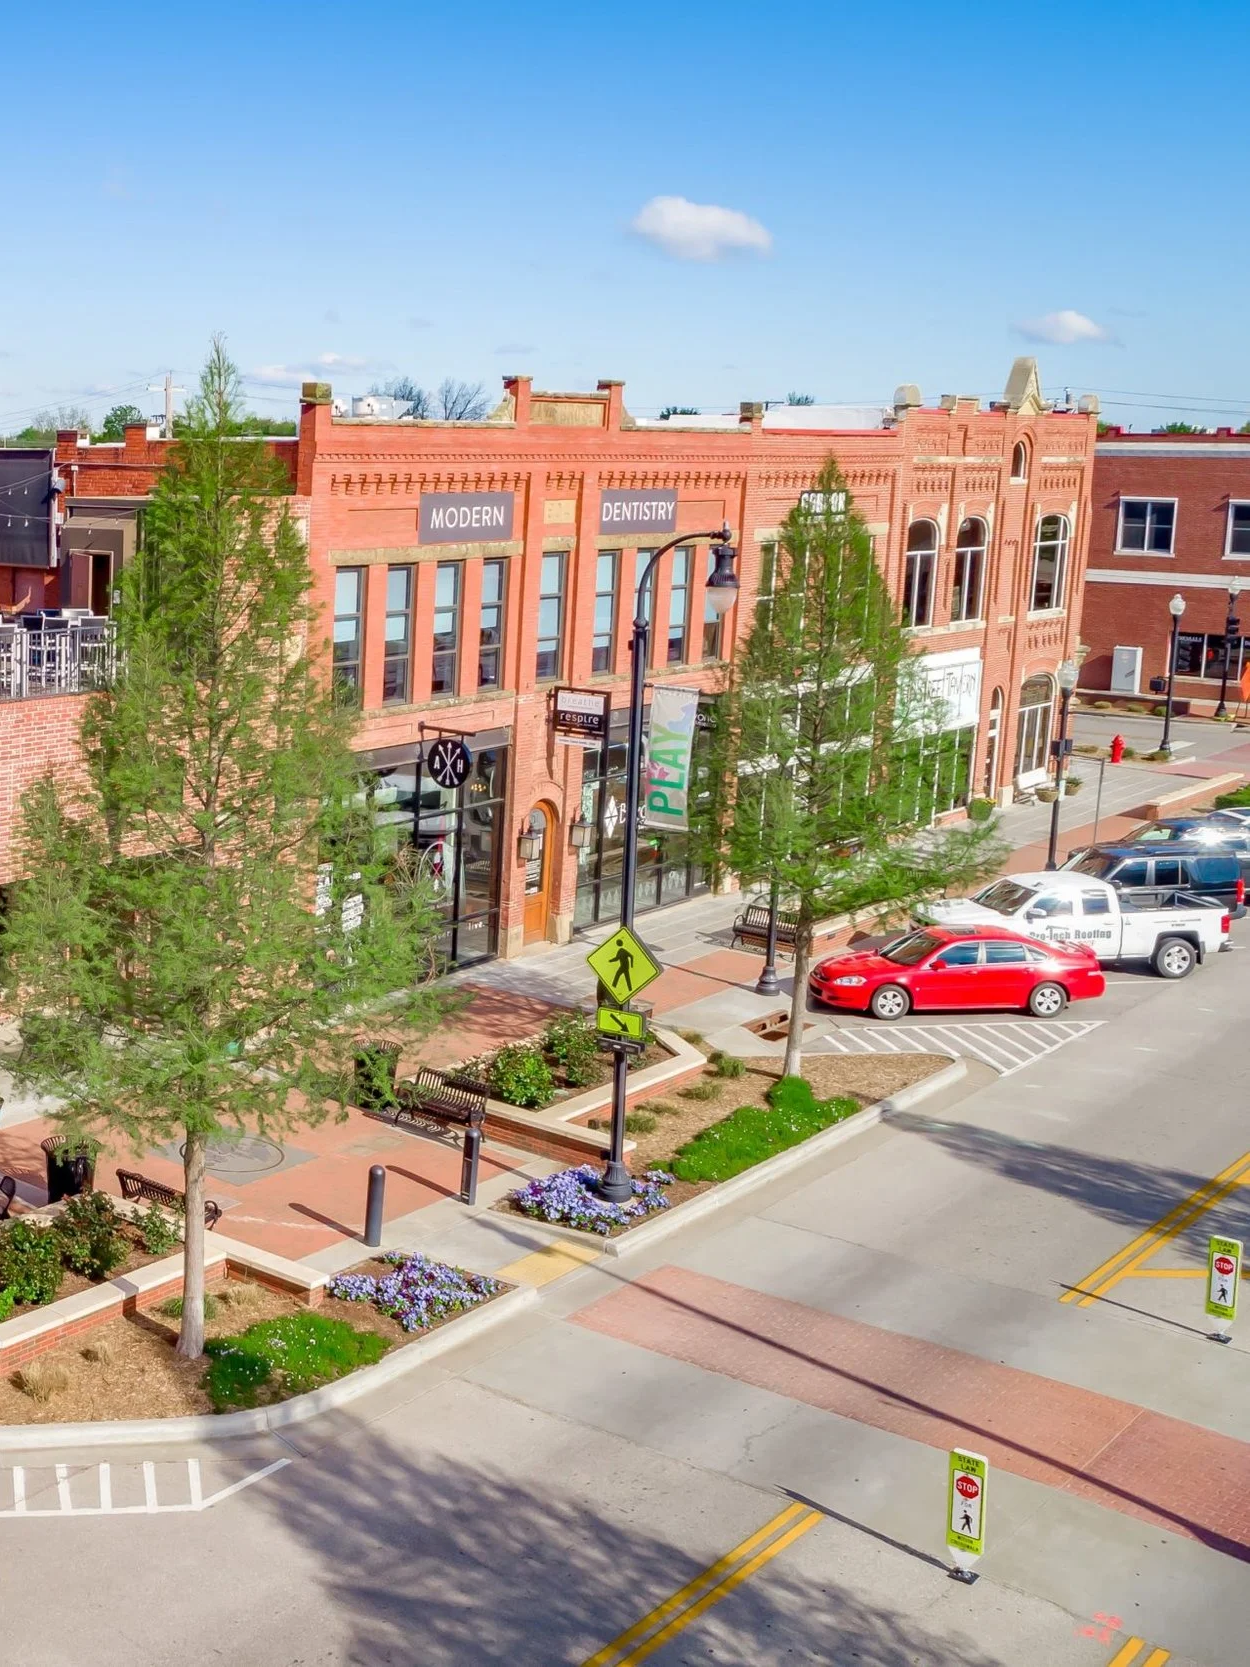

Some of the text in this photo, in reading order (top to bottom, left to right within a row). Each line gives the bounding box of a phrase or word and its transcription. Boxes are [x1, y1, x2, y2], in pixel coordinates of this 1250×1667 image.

[430, 499, 676, 529] MODERN DENTISTRY
[560, 694, 601, 708] breathe
[560, 712, 600, 726] respire
[433, 755, 464, 774] A H
[647, 724, 691, 816] PLAY
[1074, 928, 1112, 939] Roofing
[1217, 1240, 1235, 1250] STATE
[1219, 1246, 1232, 1254] LAW
[1215, 1261, 1233, 1271] STOP
[958, 1455, 980, 1468] STATE
[961, 1463, 977, 1474] LAW
[957, 1480, 978, 1494] STOP
[960, 1500, 973, 1509] FOR
